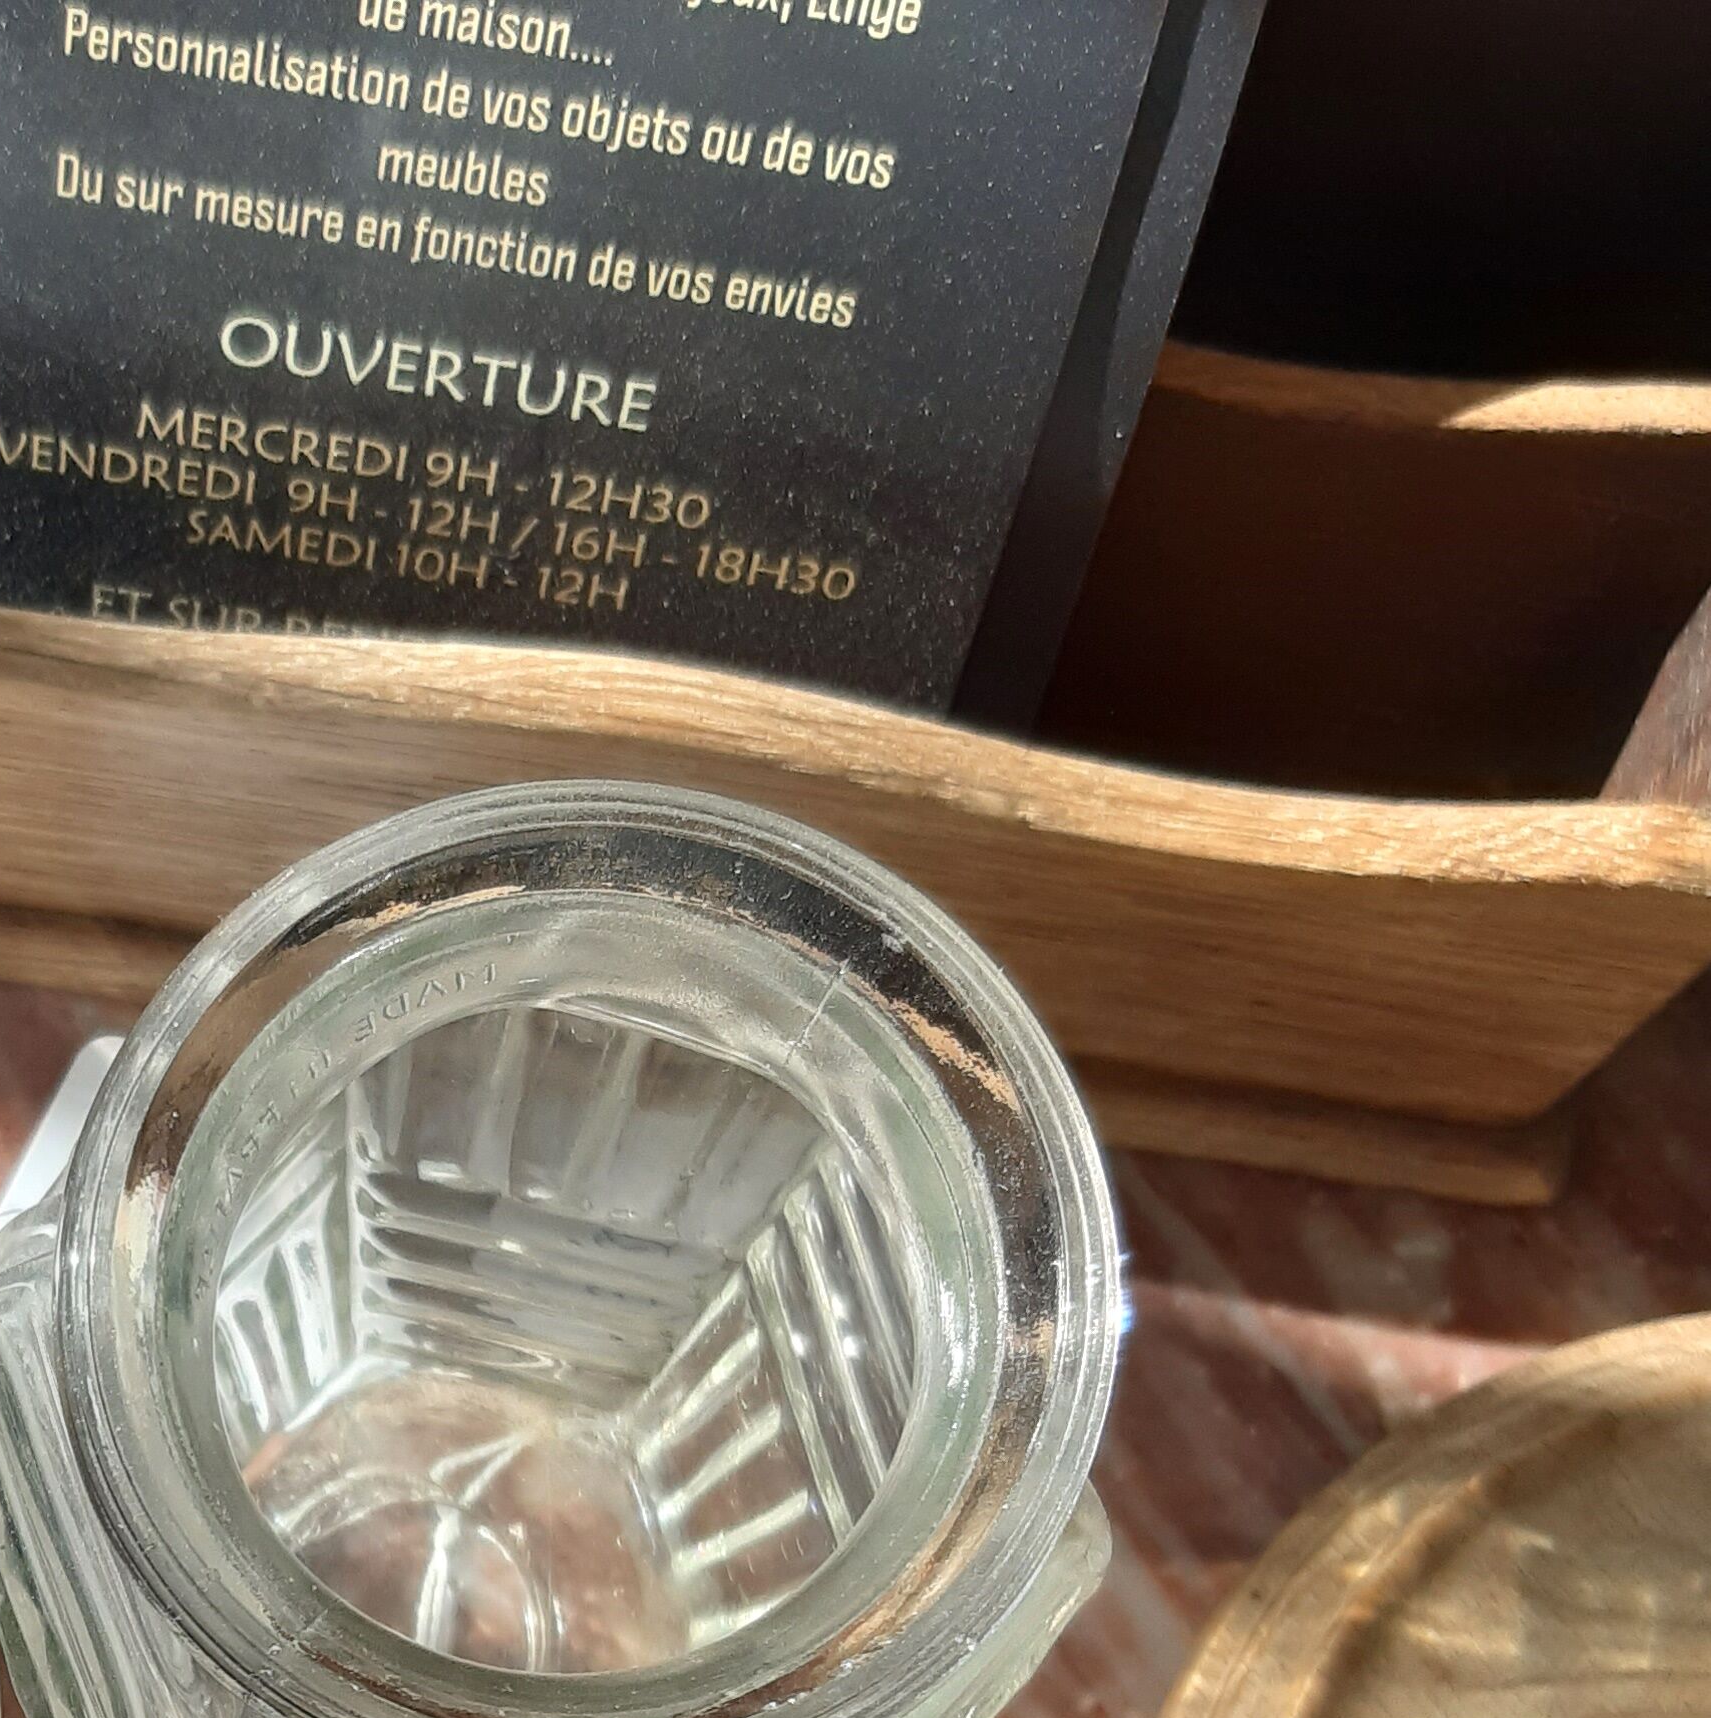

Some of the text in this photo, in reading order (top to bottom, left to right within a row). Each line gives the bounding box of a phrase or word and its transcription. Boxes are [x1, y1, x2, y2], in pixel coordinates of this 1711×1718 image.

[63, 5, 897, 190] Personnalisation de vos objets ou de vos
[55, 145, 861, 330] Du sur mesure en fonction de vos envies
[376, 142, 553, 207] meubles
[217, 308, 661, 434] OUVERTURE
[135, 398, 409, 483] MERCREDI
[425, 447, 500, 497] 9H
[550, 467, 711, 530] 12H30
[185, 508, 378, 572] SAMEDI
[397, 541, 489, 590] 10H
[537, 565, 630, 612] 12H
[287, 474, 359, 523] 9H
[408, 496, 501, 546] 12H
[554, 519, 647, 569] 16H
[696, 543, 857, 602] 18H30
[91, 583, 153, 625] ET
